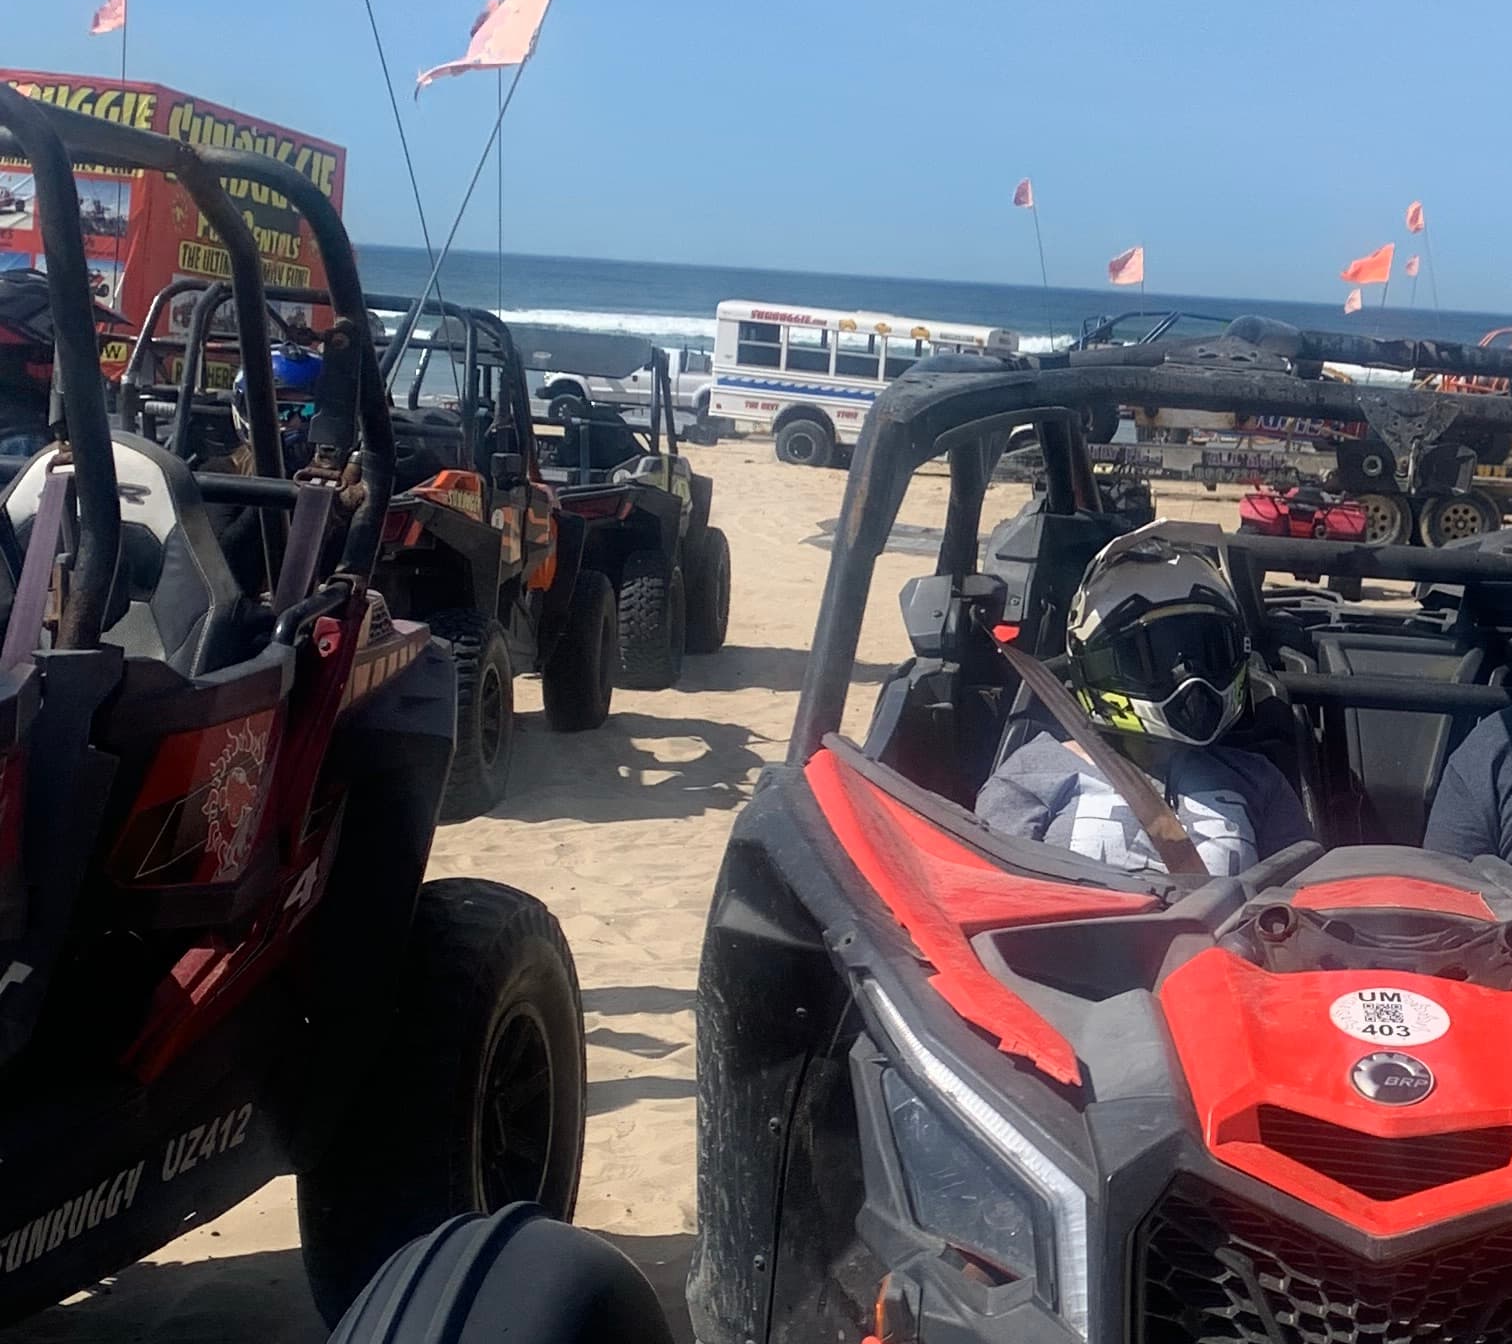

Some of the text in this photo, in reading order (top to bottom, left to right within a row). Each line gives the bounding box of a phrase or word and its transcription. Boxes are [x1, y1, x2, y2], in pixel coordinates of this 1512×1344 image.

[1358, 991, 1402, 1002] UM
[1362, 1024, 1411, 1037] 403
[1384, 1075, 1429, 1088] BRP
[162, 1103, 252, 1182] UZ412
